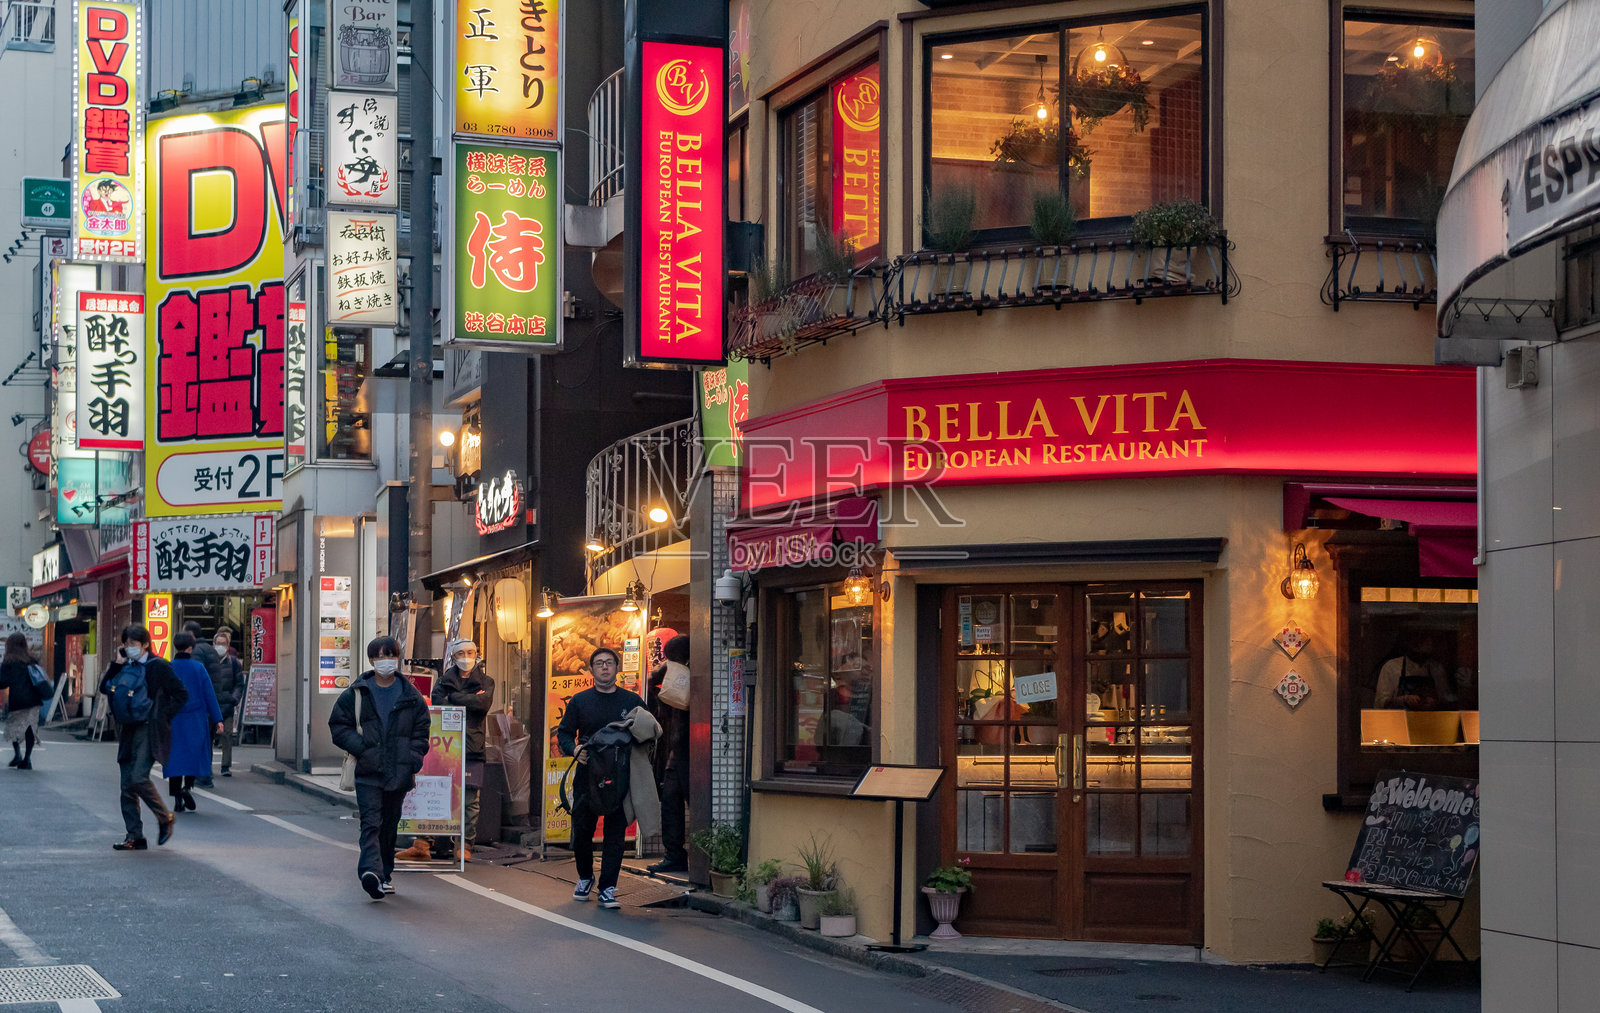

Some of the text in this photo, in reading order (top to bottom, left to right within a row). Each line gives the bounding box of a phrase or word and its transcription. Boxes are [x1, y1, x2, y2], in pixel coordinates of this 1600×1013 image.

[344, 6, 386, 21] Bar
[85, 7, 130, 176] DVD鑑賞
[463, 122, 554, 137] 03 3780 3908
[466, 152, 547, 177] 横浜家系
[466, 175, 547, 199] らーめん
[87, 217, 128, 231] 金太郎
[80, 240, 135, 256] 受付2F
[658, 131, 673, 343] EUROPEAN RESTAURANT
[675, 132, 703, 343] BELLA VITA
[332, 246, 392, 266] お好み焼
[467, 210, 545, 293] 侍
[337, 270, 386, 290] 鉄板焼
[338, 292, 392, 311] ねぎ焼き
[465, 311, 546, 336] 渋谷本店
[158, 281, 284, 442] 鑑
[84, 313, 137, 437] 酔っ手羽
[902, 389, 1207, 445] BELLA VITA
[1042, 439, 1208, 465] RESTAURANT
[153, 525, 207, 543] YOTTEBA
[260, 521, 267, 541] 1F
[155, 531, 250, 583] 酔っ手羽
[1020, 680, 1052, 697] CLOSE
[1387, 777, 1474, 816] Welcome
